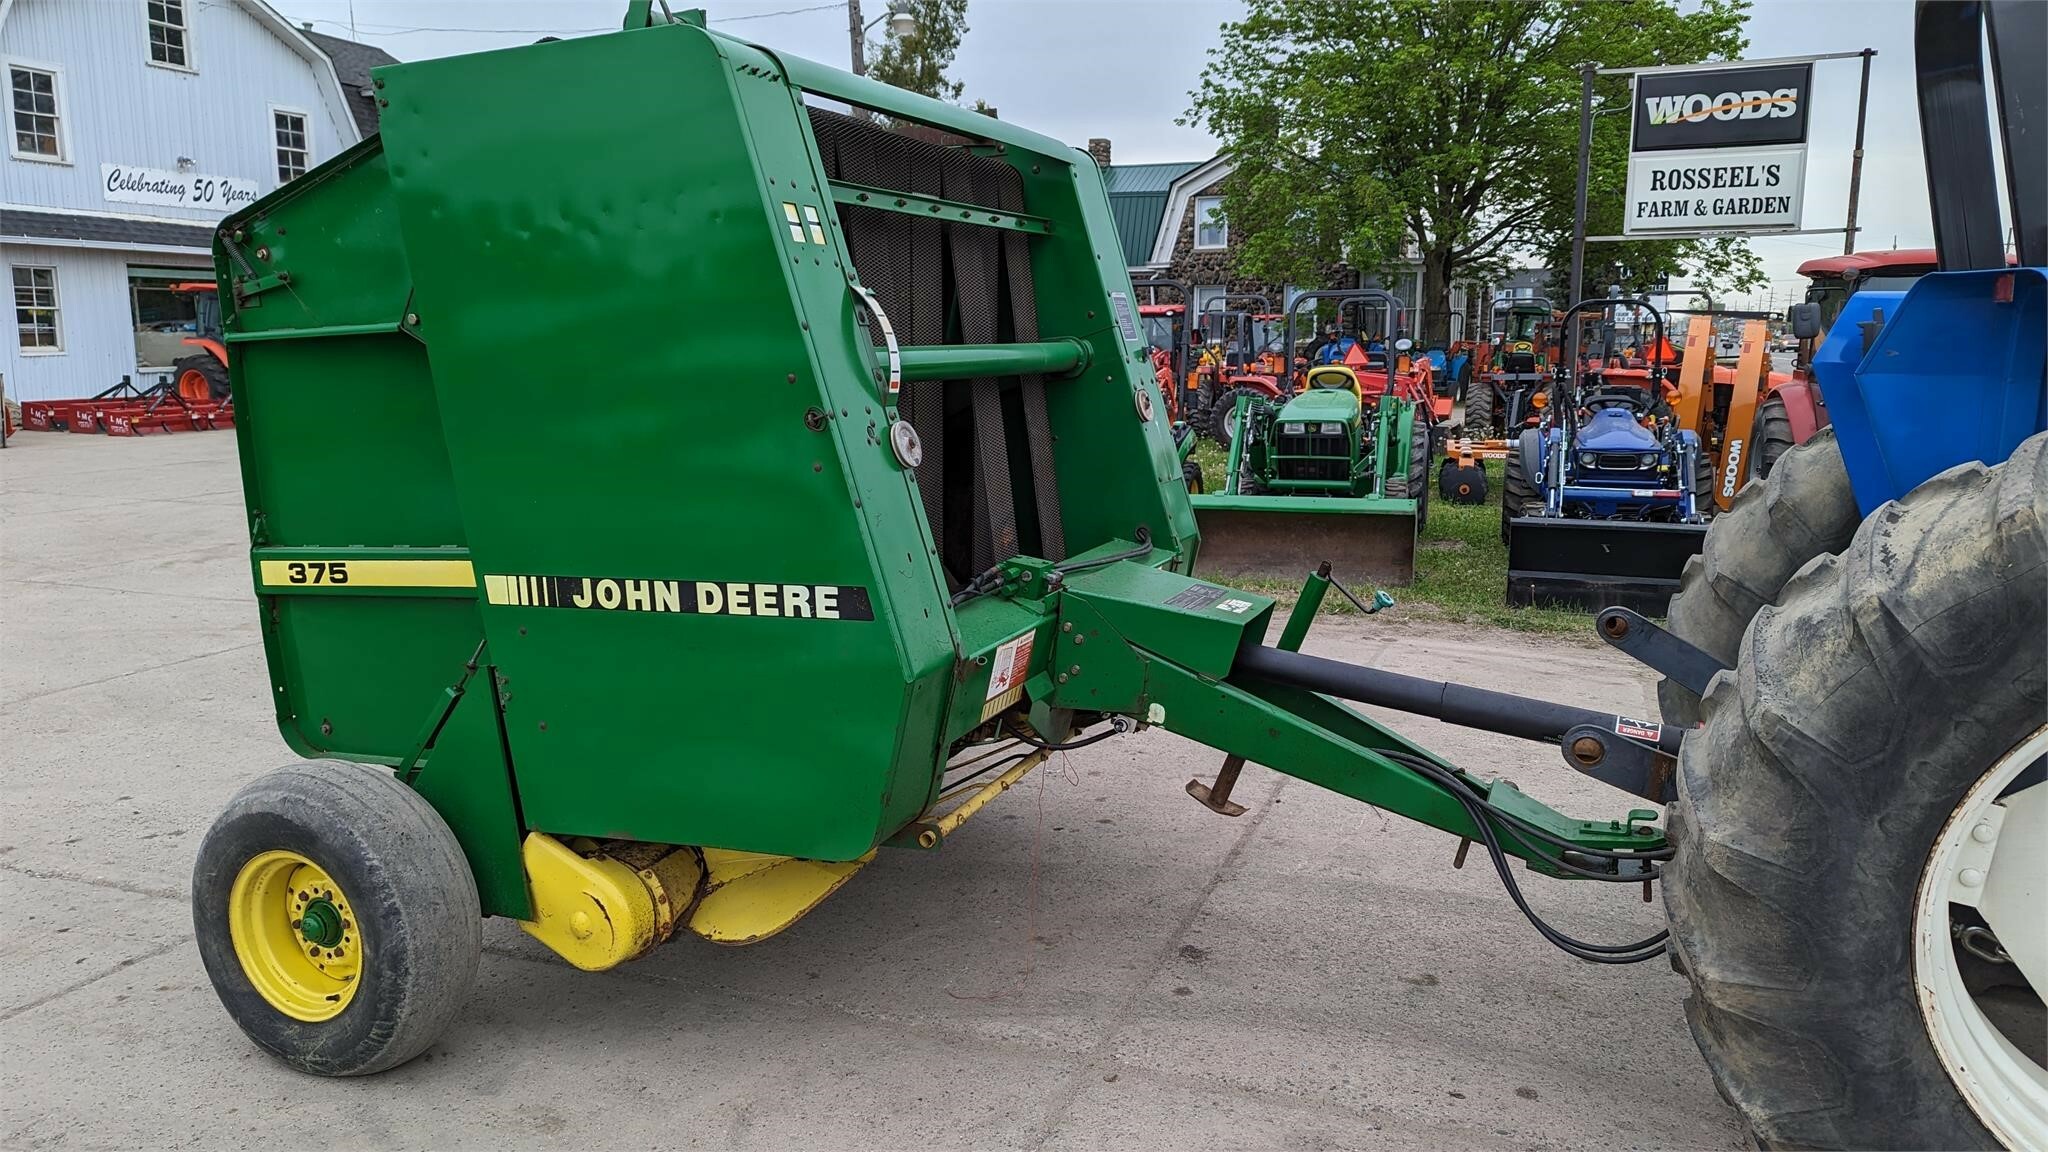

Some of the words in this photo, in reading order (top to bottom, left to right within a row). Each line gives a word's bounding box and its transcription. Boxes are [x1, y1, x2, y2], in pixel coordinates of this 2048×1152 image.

[1645, 87, 1798, 125] WOODS
[106, 168, 186, 202] Celebrating
[192, 178, 214, 202] 50
[219, 180, 257, 205] Years
[1650, 164, 1781, 191] ROSSEEL'S
[1636, 199, 1690, 218] FARM
[1693, 198, 1708, 217] &
[1712, 195, 1791, 216] GARDEN
[109, 415, 129, 428] LMC
[1722, 439, 1743, 497] WOODS
[287, 562, 349, 584] 375
[572, 578, 681, 613] JOHN
[695, 582, 840, 619] DEERE
